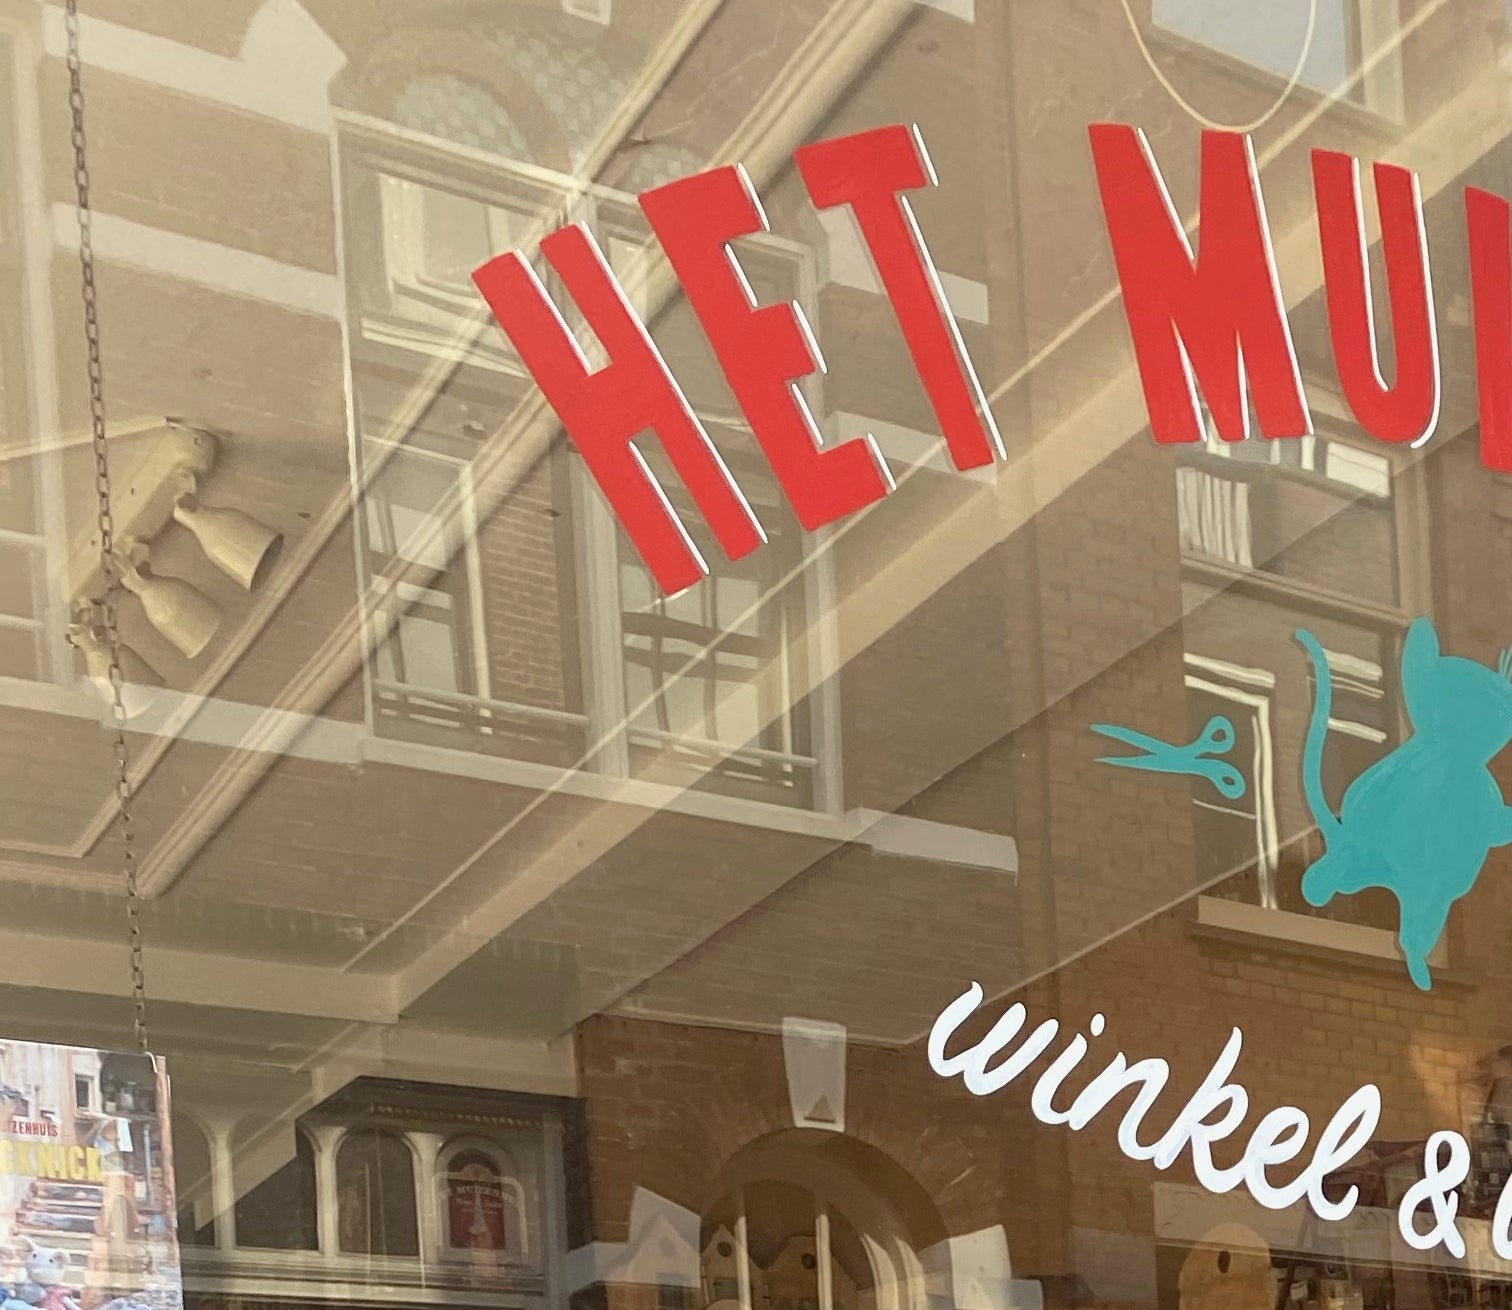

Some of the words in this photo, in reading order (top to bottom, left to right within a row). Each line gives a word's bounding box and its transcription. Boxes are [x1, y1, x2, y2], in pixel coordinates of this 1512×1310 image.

[472, 124, 1006, 597] HET
[928, 980, 1381, 1221] winkel
[1399, 1131, 1471, 1259] &
